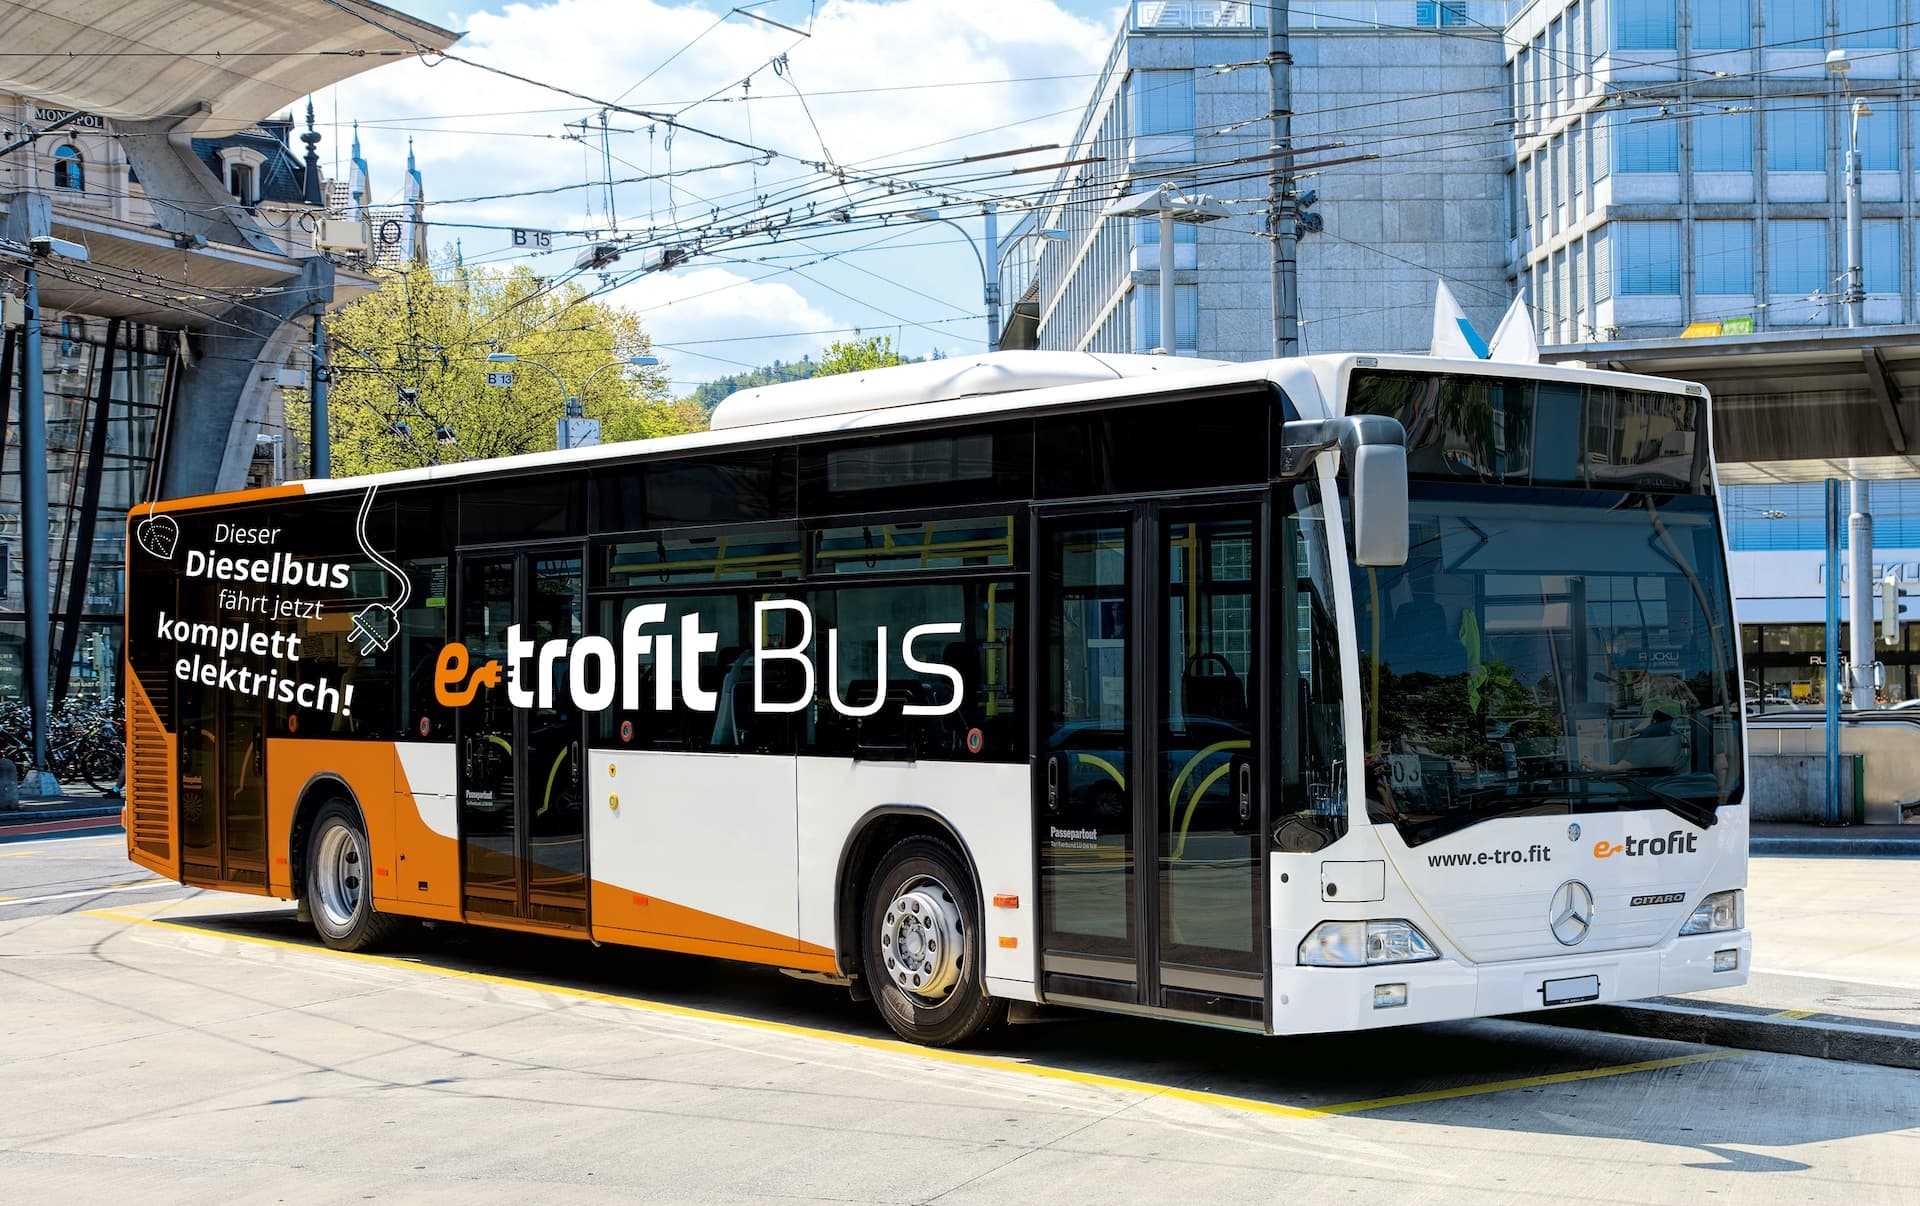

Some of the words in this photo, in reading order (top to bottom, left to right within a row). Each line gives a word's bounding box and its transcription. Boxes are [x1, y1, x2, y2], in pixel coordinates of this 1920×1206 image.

[34, 108, 103, 128] MONPOL
[514, 230, 527, 246] B
[533, 232, 551, 247] 15
[488, 373, 497, 384] B
[500, 375, 512, 384] 13
[215, 523, 281, 545] Dieser
[186, 550, 350, 589] Dieselbus
[219, 588, 269, 614] fährt
[270, 594, 325, 621] jetzt
[157, 611, 302, 661] komplett
[175, 654, 354, 717] elektrisch!
[1050, 826, 1097, 840] Passepartout
[1428, 845, 1551, 867] www.e-tro.fit
[1632, 893, 1684, 906] CITARO
